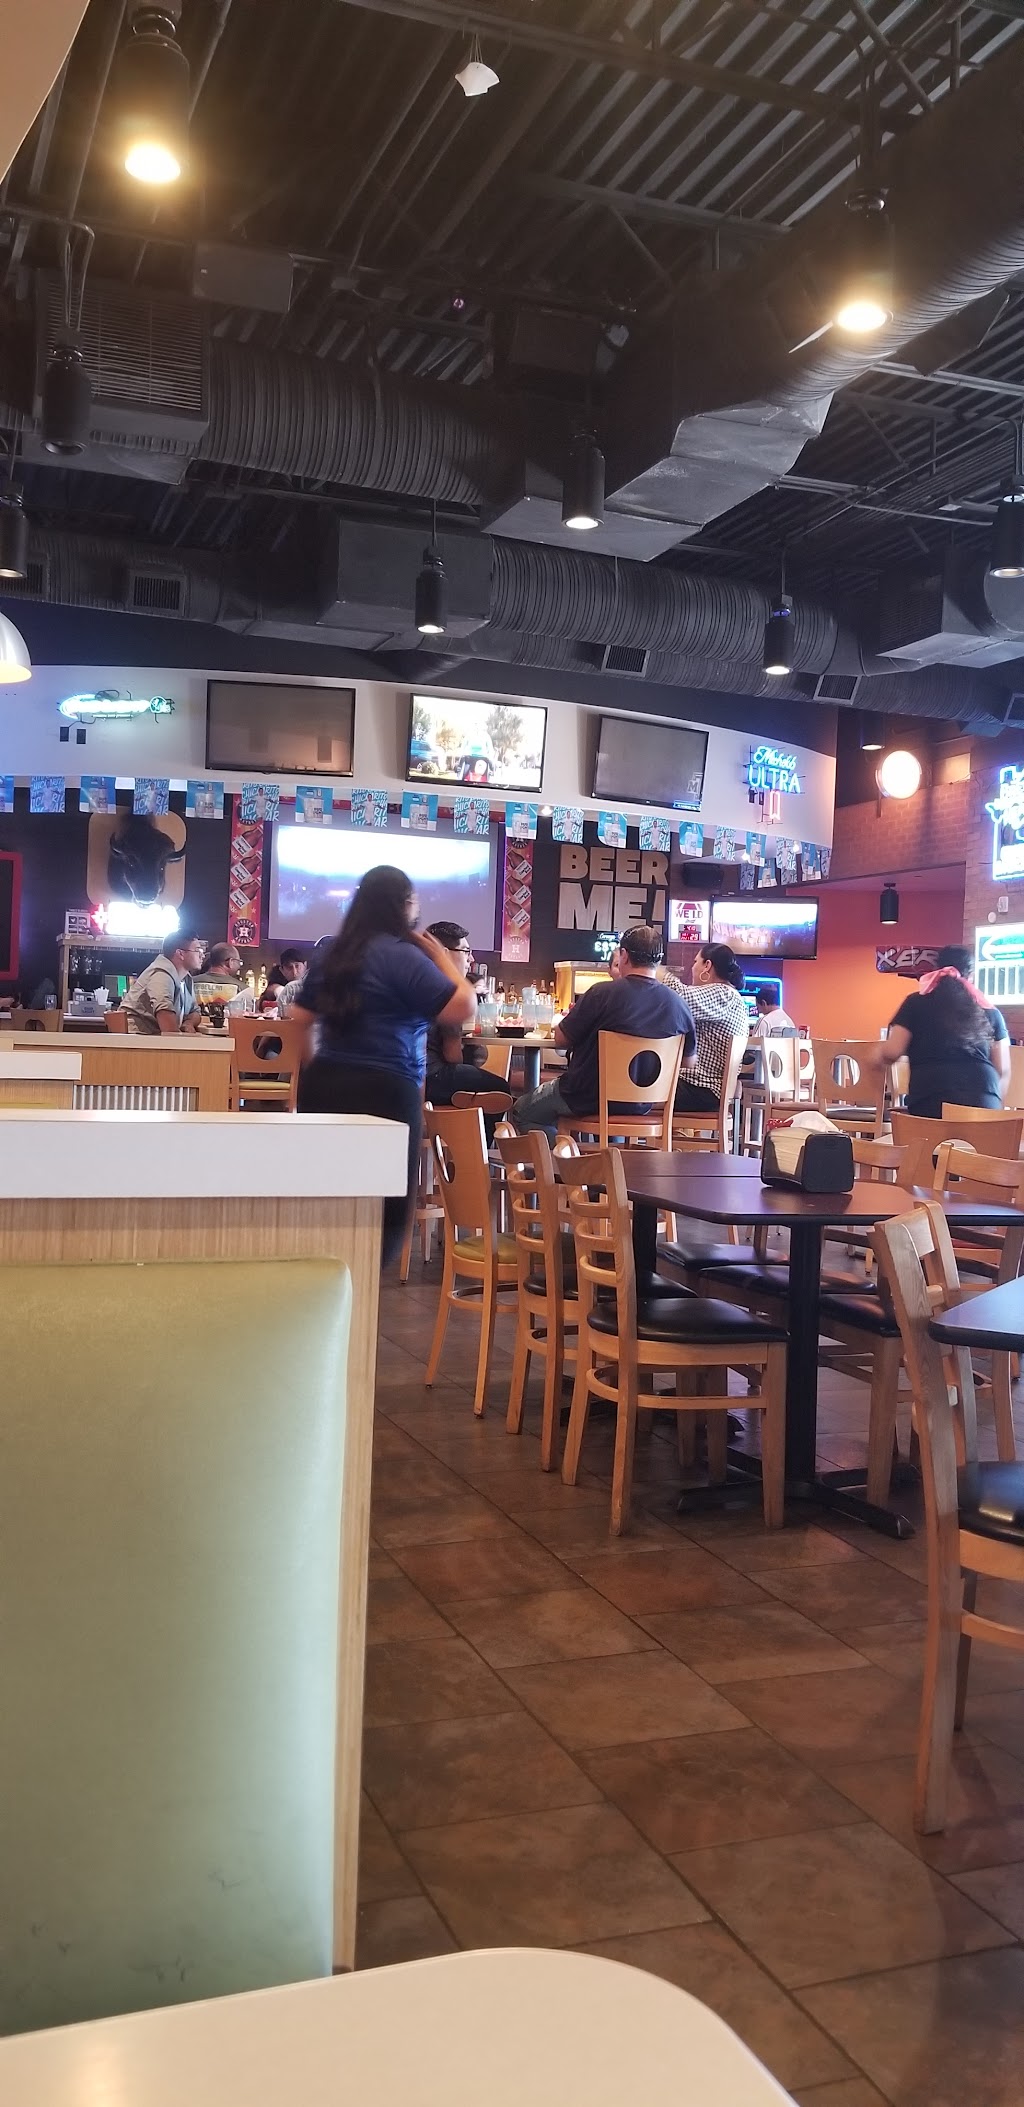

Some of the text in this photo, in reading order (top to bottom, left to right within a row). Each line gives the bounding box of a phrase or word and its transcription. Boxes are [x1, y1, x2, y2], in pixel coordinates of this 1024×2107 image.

[748, 764, 801, 794] ULTRA
[560, 844, 668, 885] BEER
[557, 882, 666, 934] ME!
